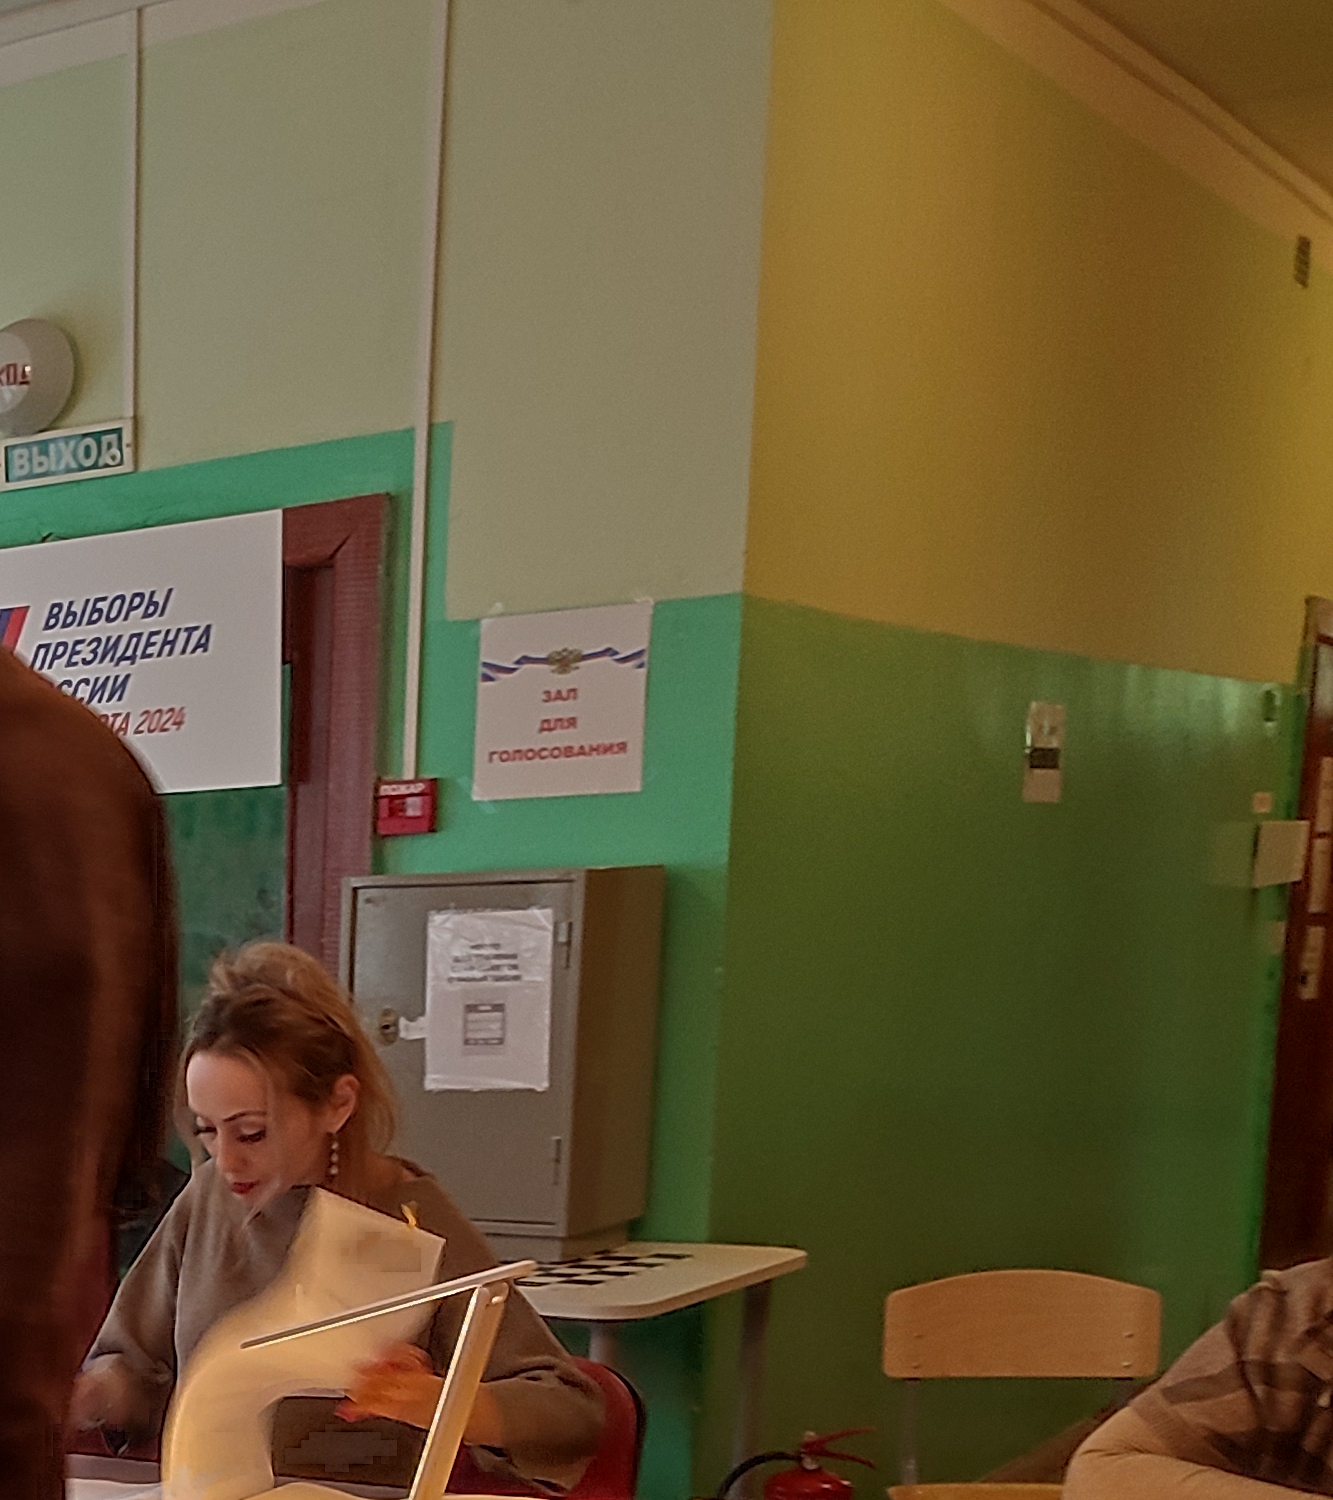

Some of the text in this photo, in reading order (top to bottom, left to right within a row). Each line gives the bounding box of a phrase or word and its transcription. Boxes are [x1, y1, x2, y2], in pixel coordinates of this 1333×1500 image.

[12, 433, 121, 478] ВЫХОД
[42, 587, 175, 631] ВЫБОРЫ
[29, 623, 213, 671] ПРЕЗИДЕНТА
[542, 688, 579, 703] ЗАЛ
[133, 707, 186, 735] 2024
[538, 716, 578, 734] ДЛЯ
[488, 741, 628, 763] ГОЛОСОВАНИЯ
